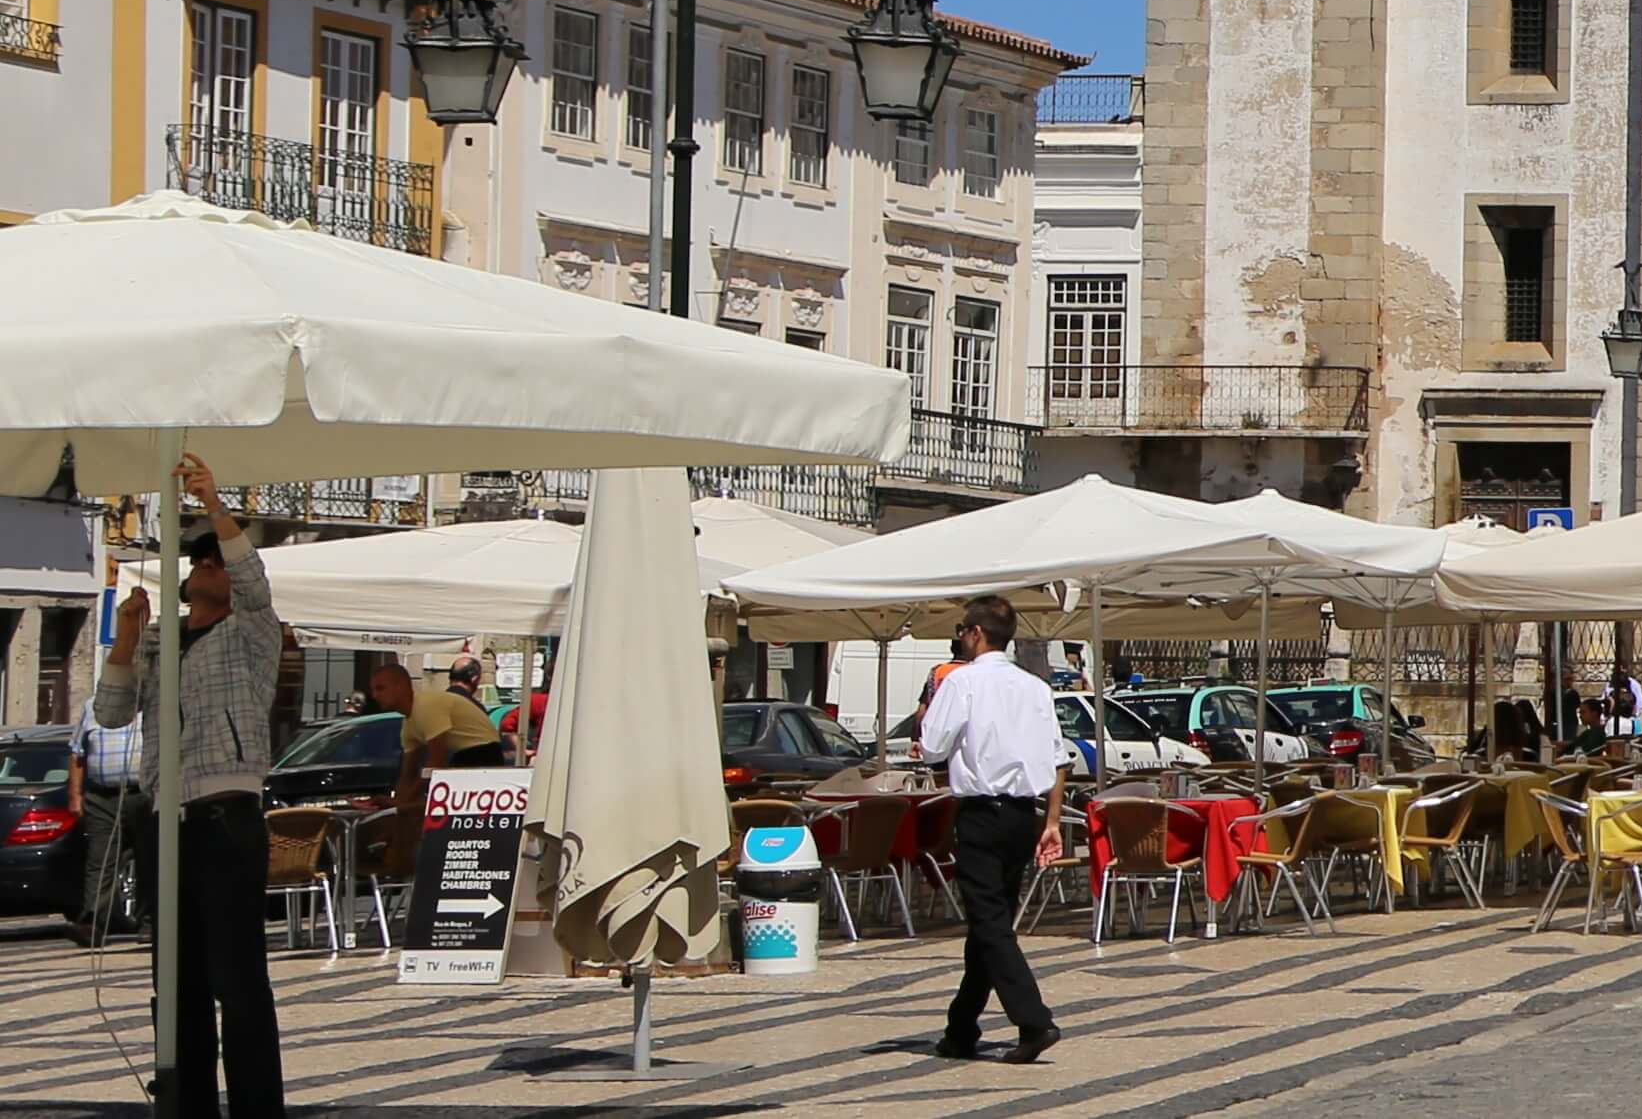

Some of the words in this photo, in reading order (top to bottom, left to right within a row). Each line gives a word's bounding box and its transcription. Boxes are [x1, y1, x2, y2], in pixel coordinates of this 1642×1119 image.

[424, 782, 528, 832] Burgos
[451, 816, 521, 830] hostel
[447, 840, 491, 850] QUARTOS
[445, 850, 479, 859] ROOMS
[443, 860, 479, 870] ZIMMER
[442, 870, 511, 880] HABITACIONES
[440, 880, 492, 890] CHAMBRES
[743, 901, 777, 917] alise
[426, 961, 440, 972] TV
